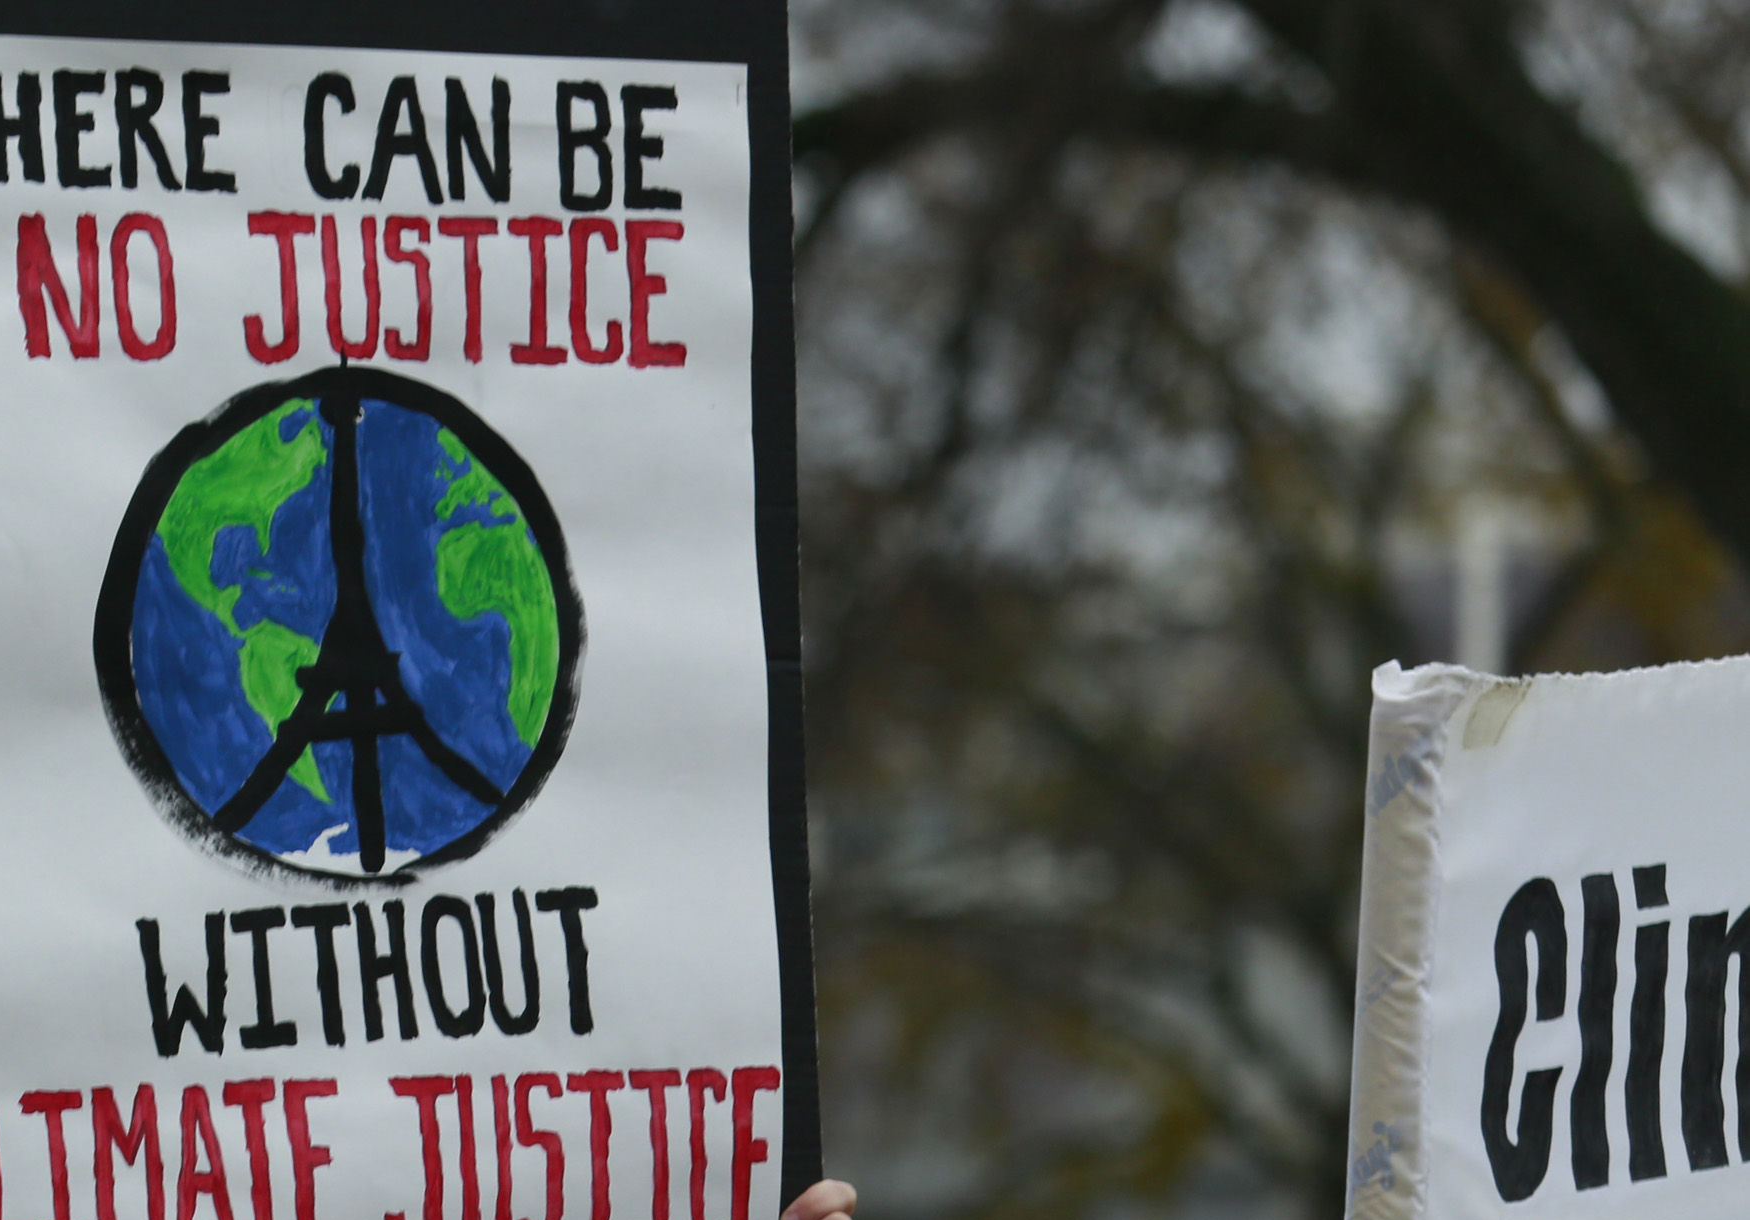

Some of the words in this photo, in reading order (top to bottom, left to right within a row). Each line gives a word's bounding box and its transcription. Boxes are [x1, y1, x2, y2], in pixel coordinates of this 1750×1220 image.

[303, 72, 512, 205] CAN
[556, 80, 682, 211] BE
[16, 211, 176, 361] NO
[243, 210, 686, 368] JUSTICE
[136, 887, 598, 1058] WITHOUT
